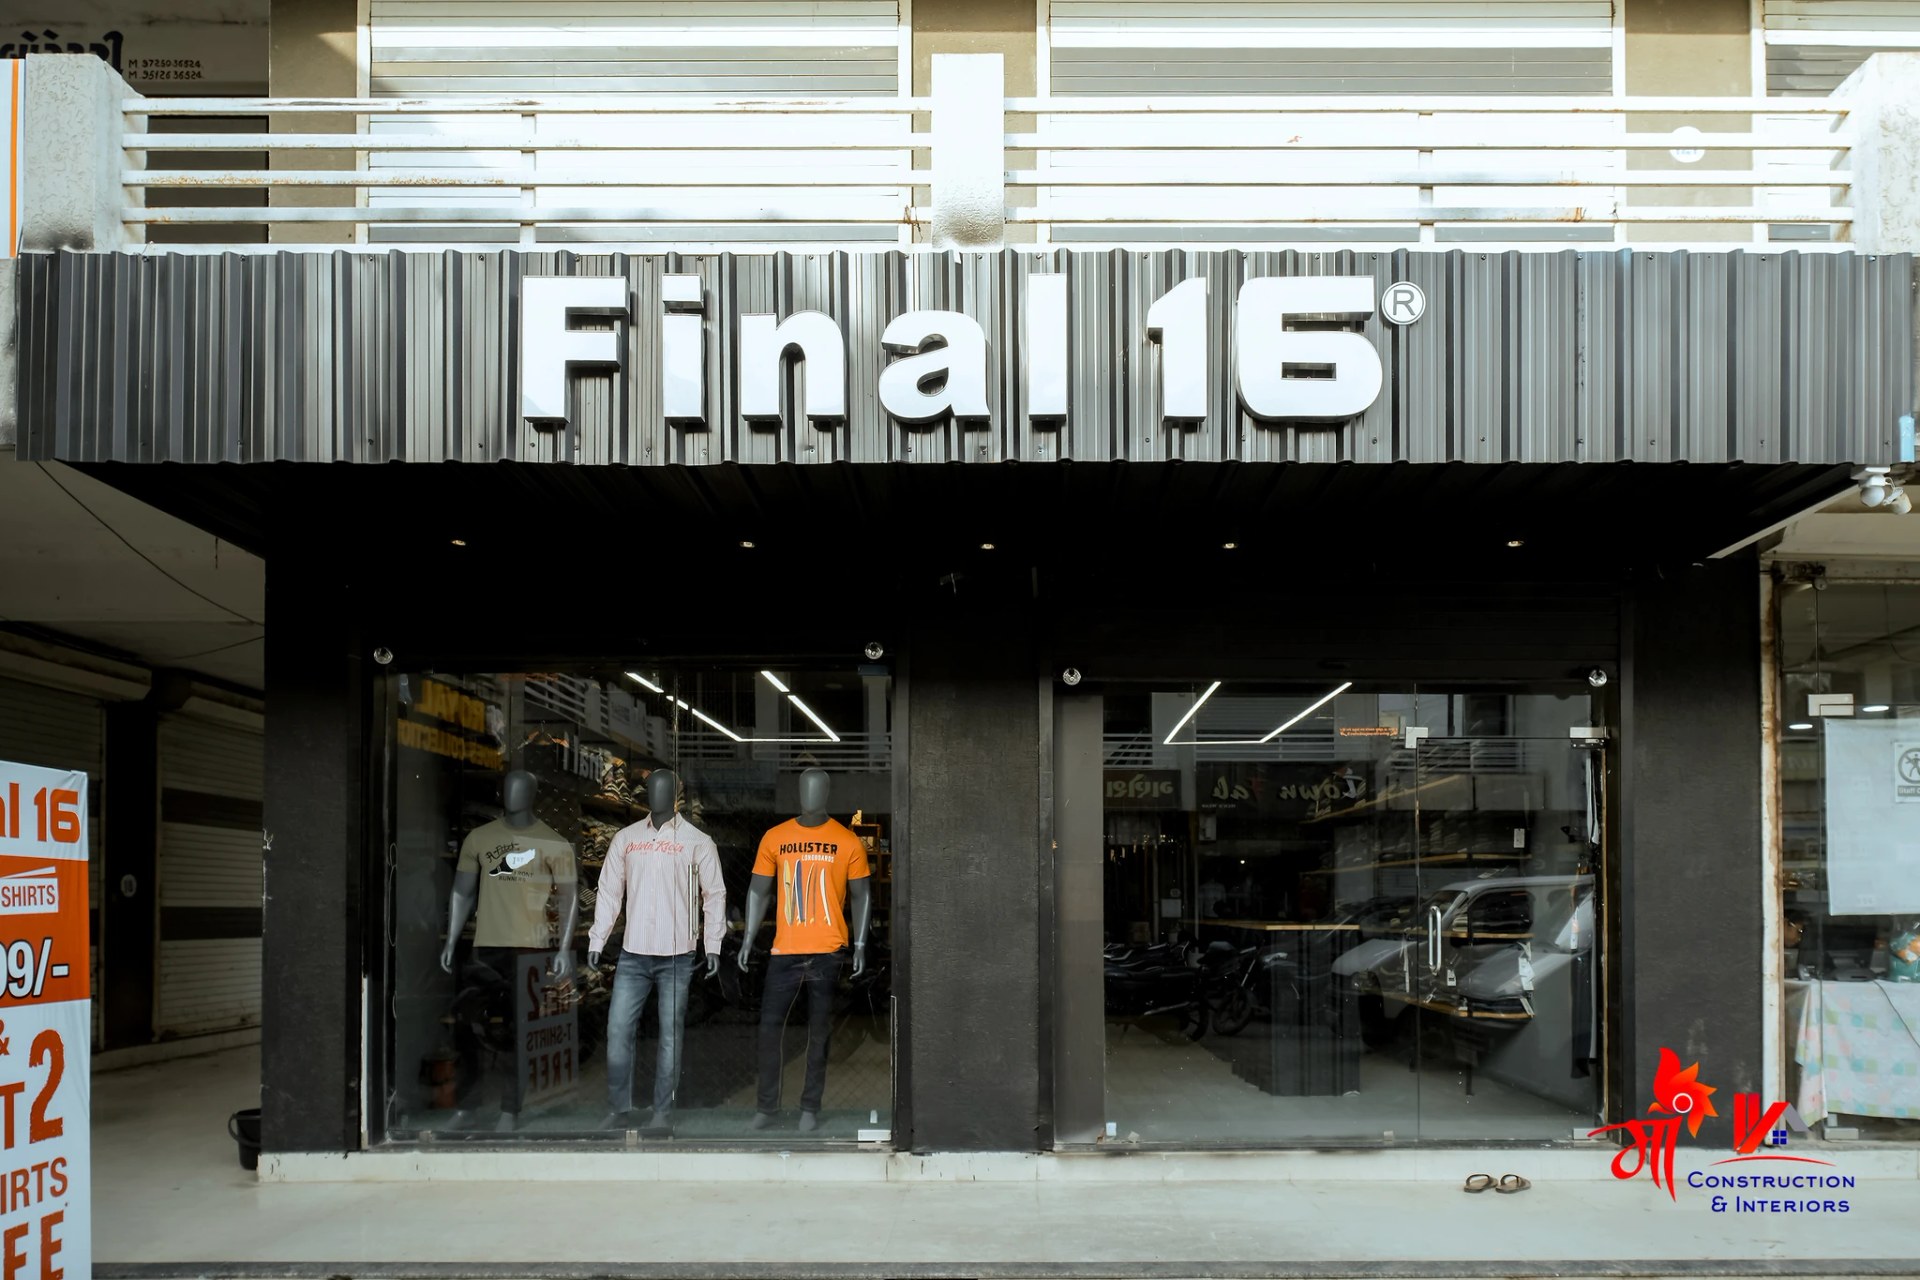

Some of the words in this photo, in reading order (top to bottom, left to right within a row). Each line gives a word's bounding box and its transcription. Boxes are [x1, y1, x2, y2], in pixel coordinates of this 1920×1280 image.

[521, 273, 1070, 425] Final
[1146, 274, 1384, 424] 16
[34, 786, 80, 843] 16
[779, 842, 838, 855] HOLLISTER
[1, 884, 56, 907] SHIRTS
[0, 937, 69, 999] 9/-
[29, 1029, 64, 1144] 2
